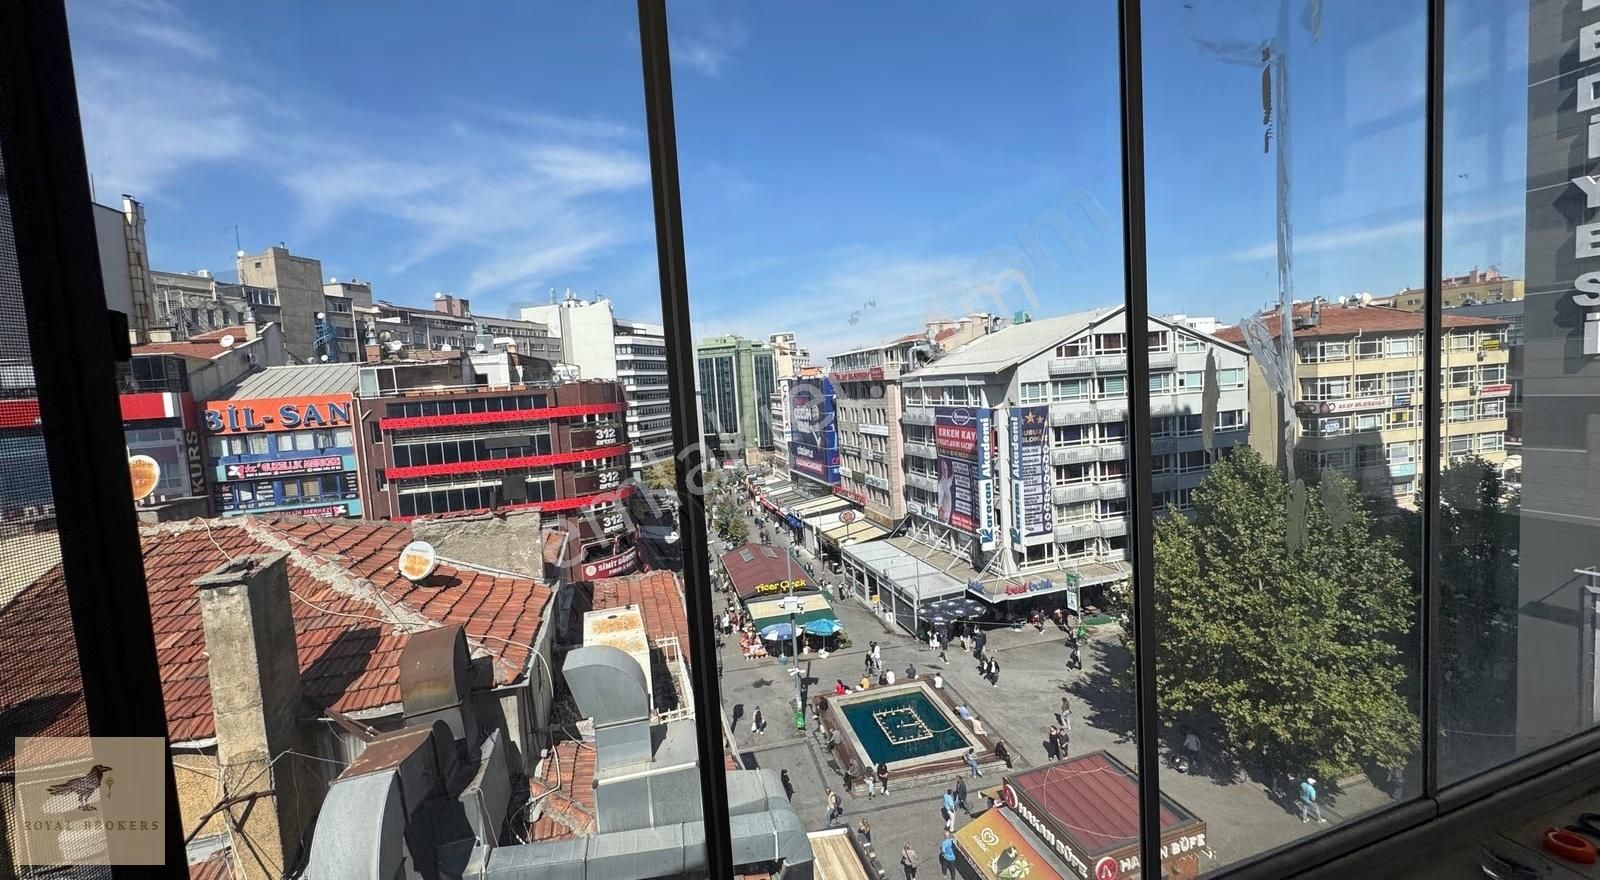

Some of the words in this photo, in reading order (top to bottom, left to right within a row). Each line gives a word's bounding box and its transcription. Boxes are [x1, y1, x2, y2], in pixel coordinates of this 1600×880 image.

[596, 428, 616, 440] 312
[938, 427, 960, 439] ERKEN
[980, 417, 991, 477] Akademi
[186, 431, 205, 494] KURS
[599, 471, 619, 483] 312
[603, 513, 623, 527] 312
